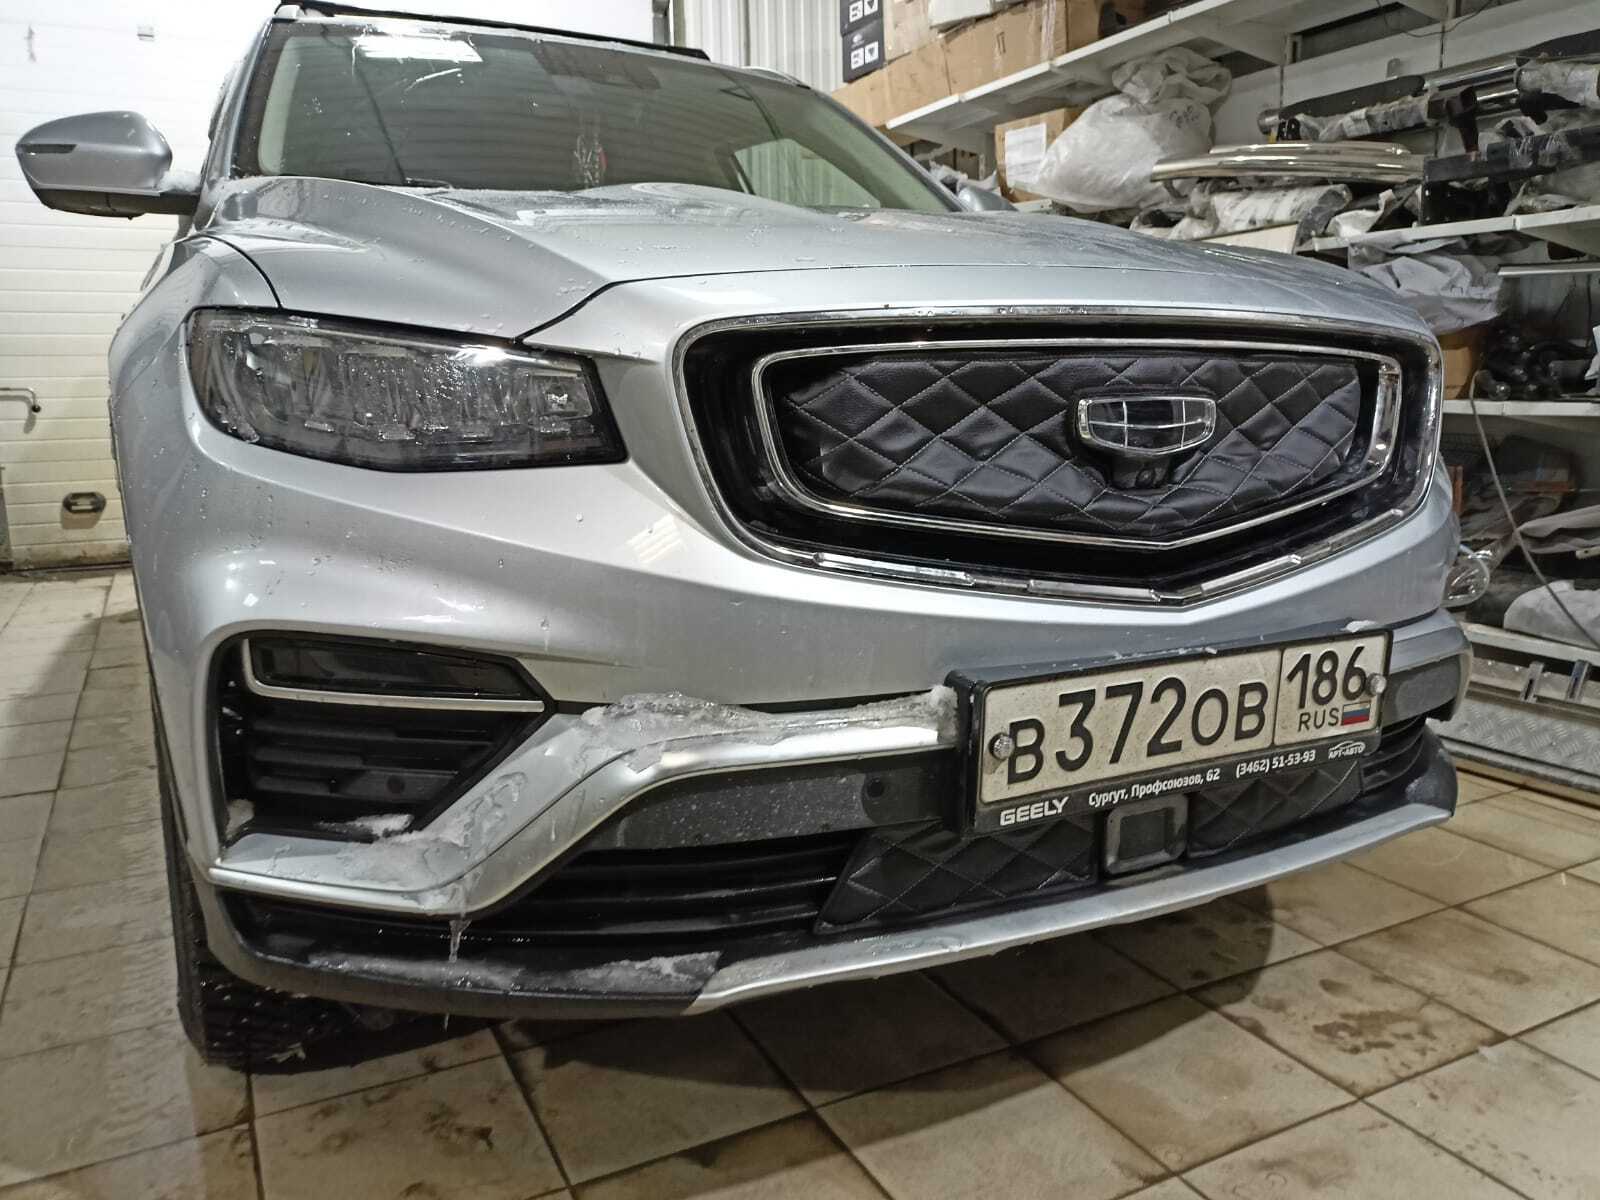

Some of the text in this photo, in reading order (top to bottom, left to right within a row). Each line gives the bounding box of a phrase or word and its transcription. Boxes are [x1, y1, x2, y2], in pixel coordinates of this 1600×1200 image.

[1286, 646, 1367, 709] 186
[1298, 707, 1340, 732] RUS
[1235, 750, 1316, 778] (3462) 51-53-93
[1088, 768, 1221, 808] Сургут, Профсоюзов, 62
[1000, 796, 1068, 826] GEELY
